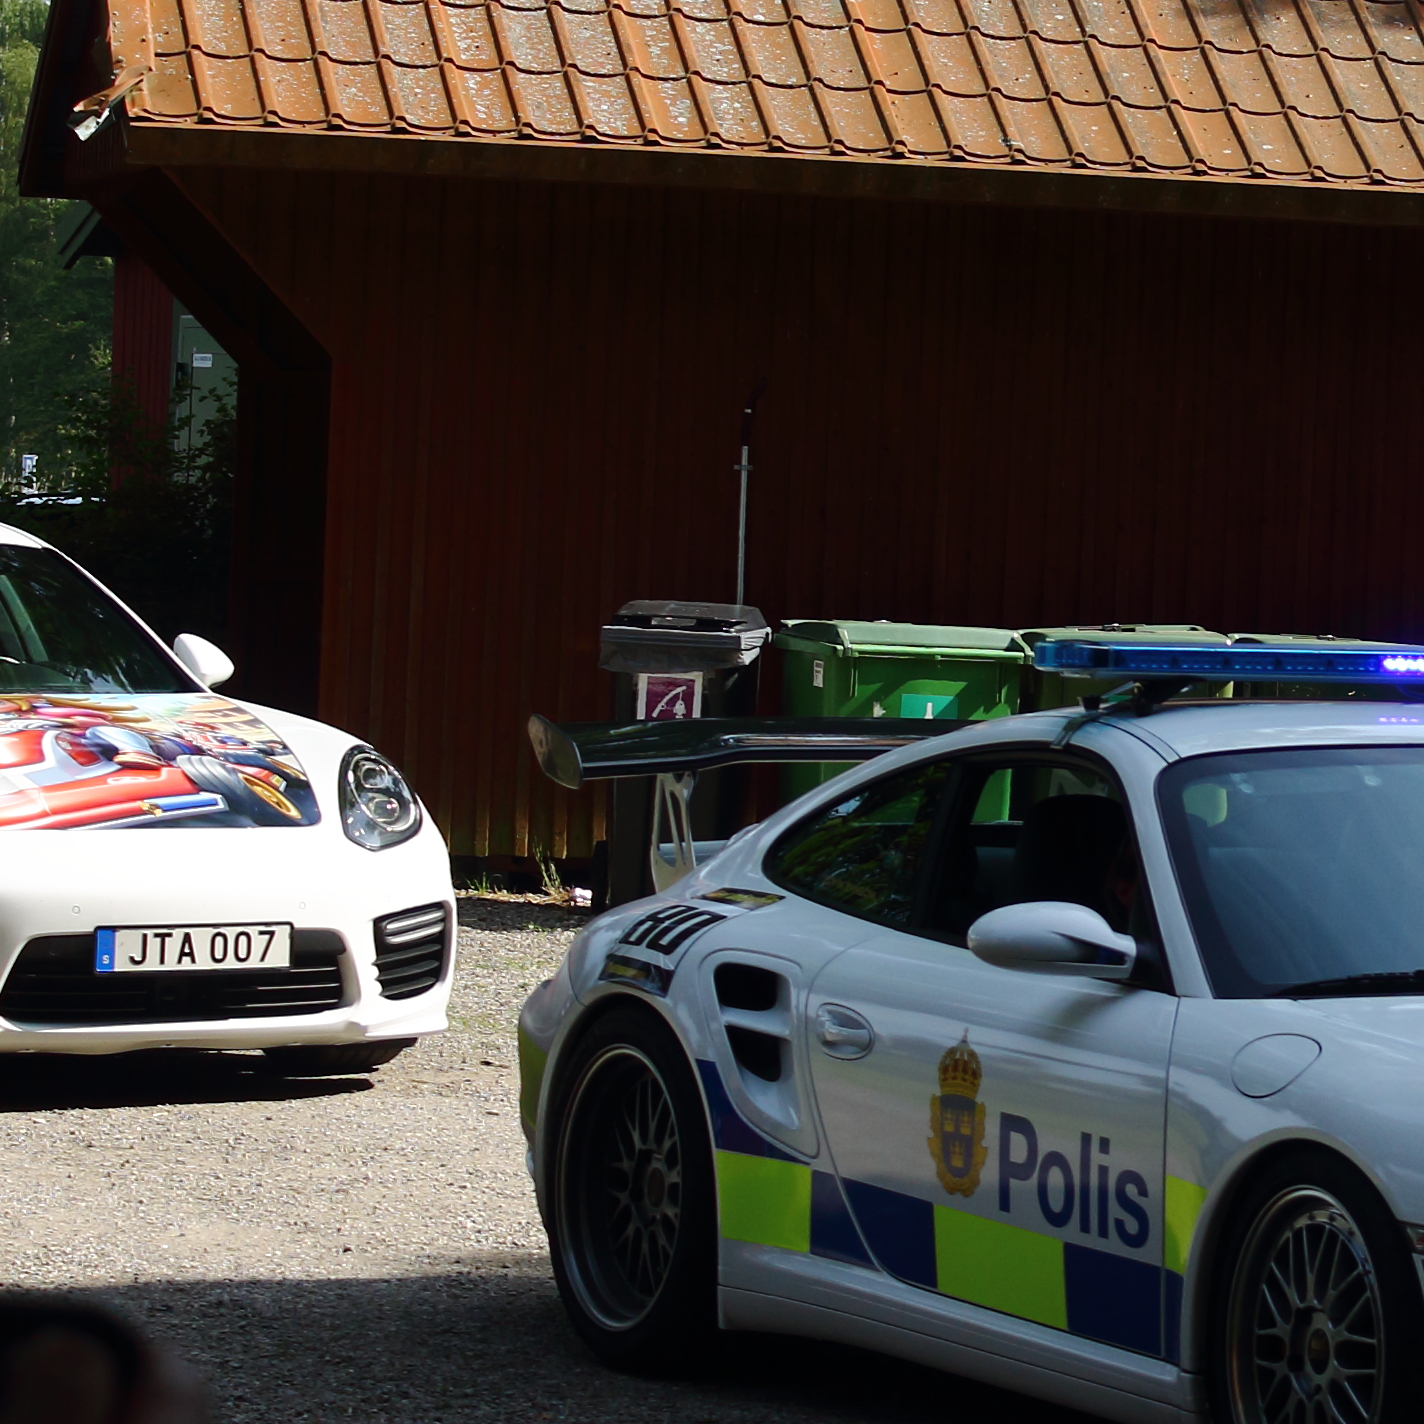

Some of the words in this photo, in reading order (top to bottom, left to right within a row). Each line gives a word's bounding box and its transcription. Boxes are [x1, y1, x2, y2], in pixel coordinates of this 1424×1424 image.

[101, 954, 110, 965] S
[128, 931, 197, 965] JTA
[209, 930, 276, 964] 007
[999, 1111, 1149, 1249] Polis
